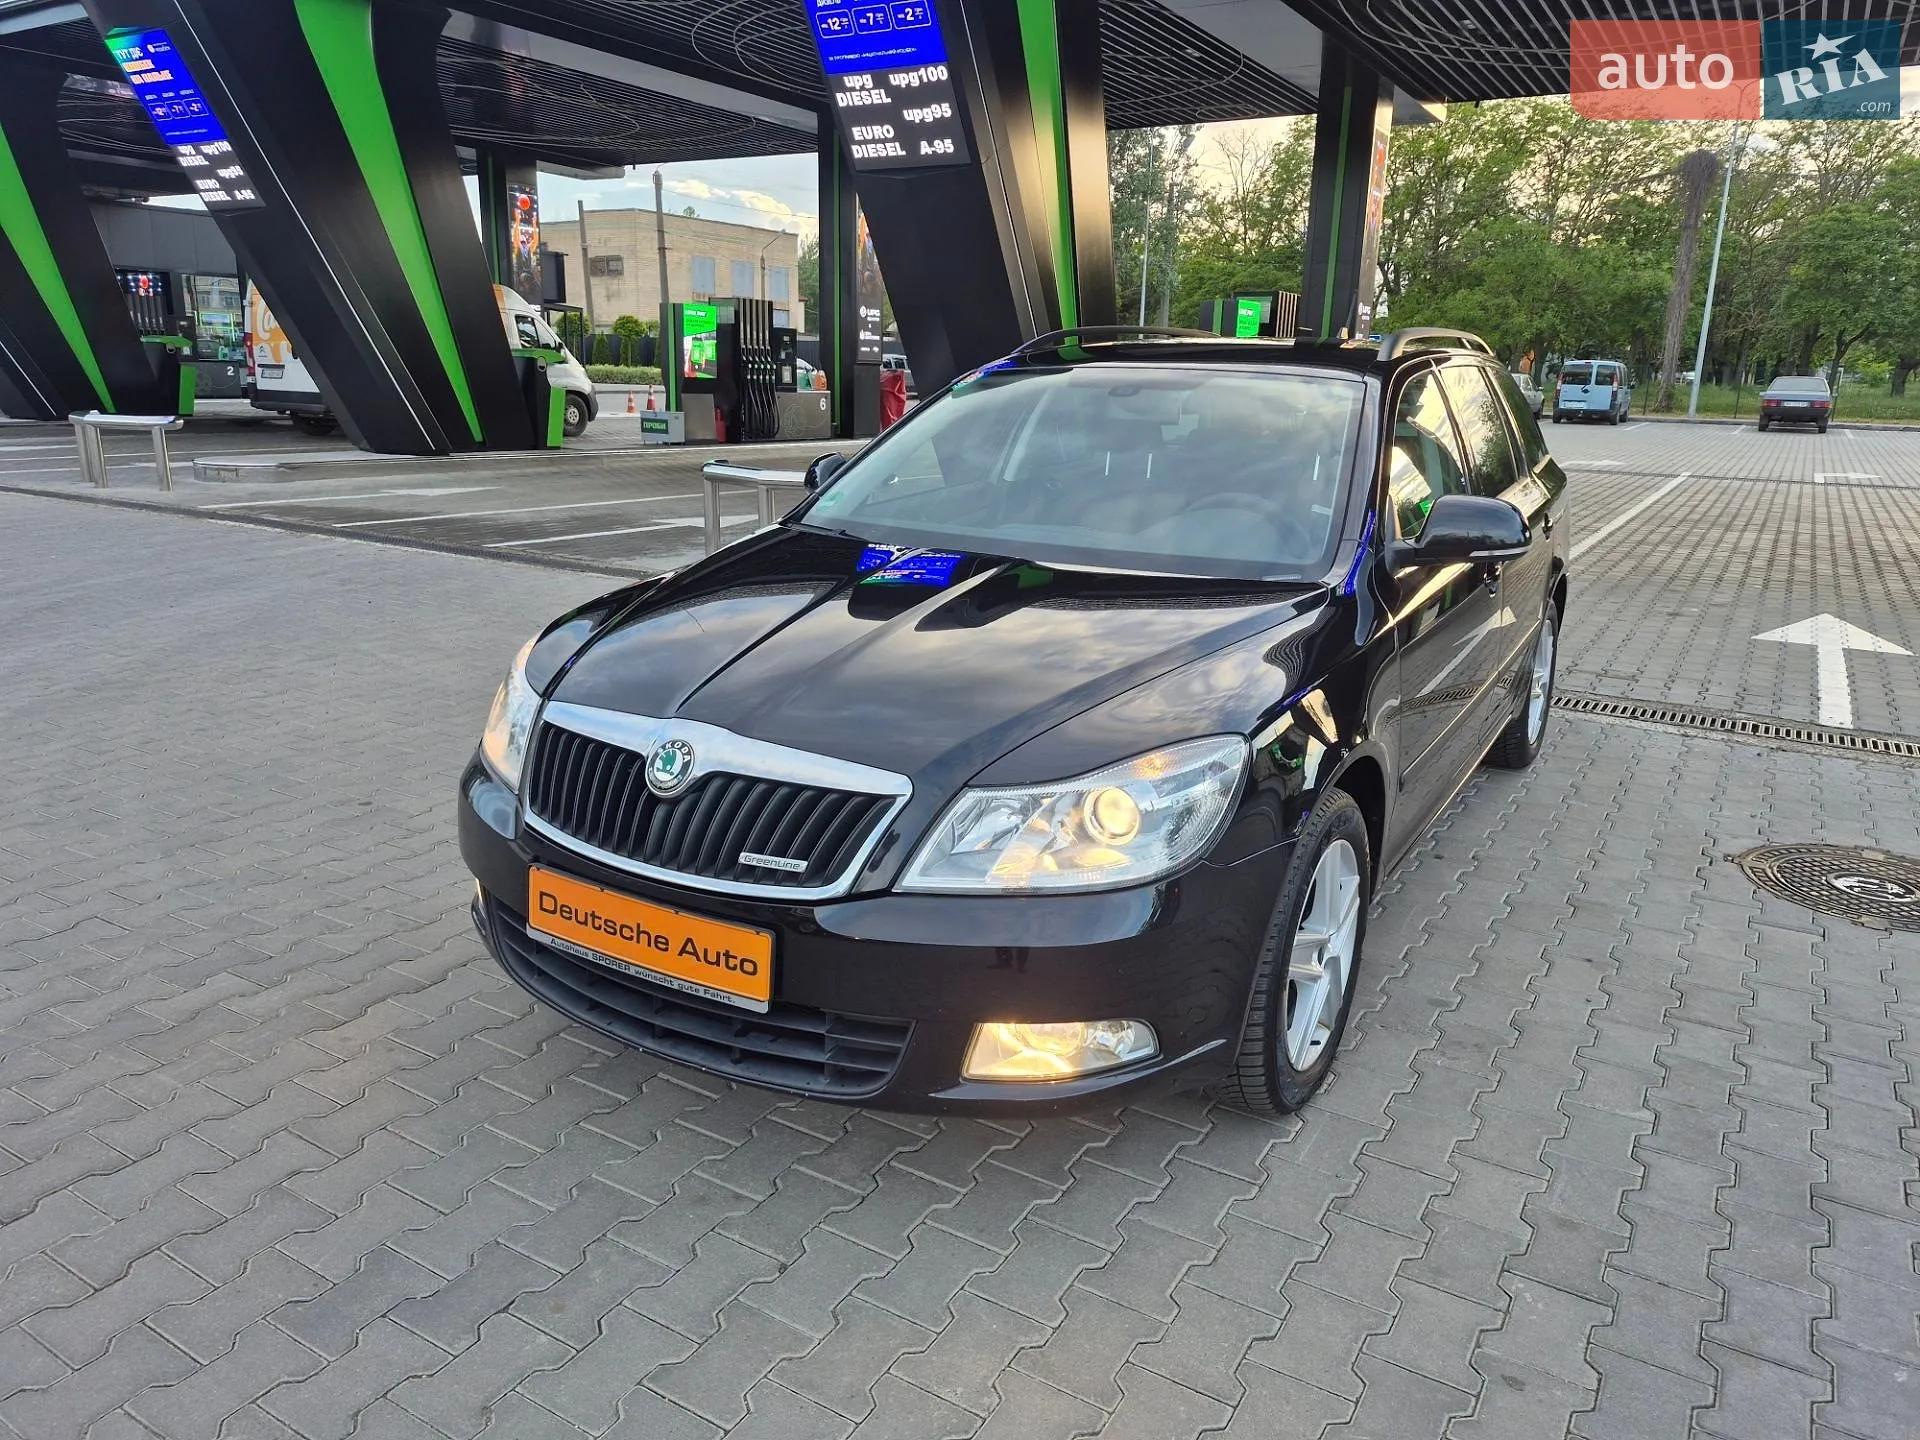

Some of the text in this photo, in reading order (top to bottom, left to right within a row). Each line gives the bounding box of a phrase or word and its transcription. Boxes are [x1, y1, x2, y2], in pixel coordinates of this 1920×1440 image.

[843, 74, 873, 89] upg
[888, 65, 949, 88] upg100
[835, 89, 892, 107] DIESEL
[902, 103, 952, 123] upg95
[851, 125, 895, 140] EURO
[851, 142, 906, 159] DIESEL
[920, 139, 954, 155] A-95
[178, 155, 210, 167] DIESEL
[195, 179, 220, 190] EURO
[200, 191, 232, 202] DIESEL
[226, 366, 234, 376] 2
[819, 398, 827, 411] 6
[744, 854, 801, 870] GreenLine
[538, 889, 759, 977] Deutsche Auto
[550, 937, 590, 959] Autohaus
[677, 980, 701, 995] gute
[703, 988, 736, 1004] Fahrt.
